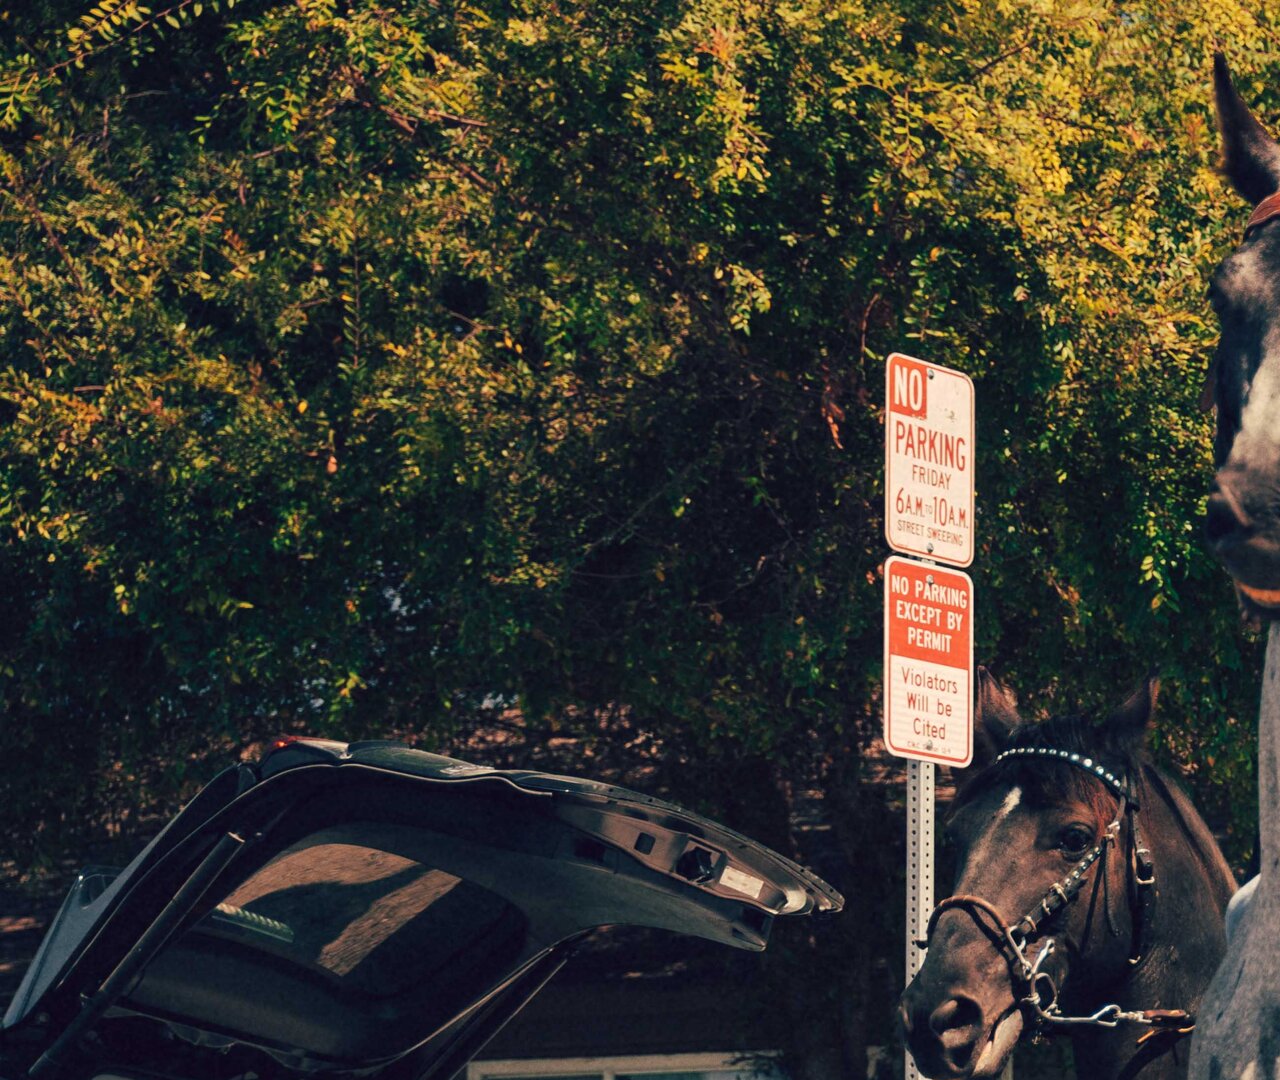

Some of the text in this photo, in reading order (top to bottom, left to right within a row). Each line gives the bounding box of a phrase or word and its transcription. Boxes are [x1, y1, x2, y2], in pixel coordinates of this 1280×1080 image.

[894, 364, 923, 411] NO
[896, 420, 966, 471] PARKING
[912, 464, 951, 491] FRIDAY
[897, 519, 963, 546] STREET SWEEPING
[891, 574, 968, 609] NO PARKING
[896, 600, 964, 631] EXCEPT BY
[907, 627, 952, 653] PERMIT
[902, 666, 958, 694] Violators
[907, 692, 952, 717] Will be
[913, 718, 946, 740] Cited
